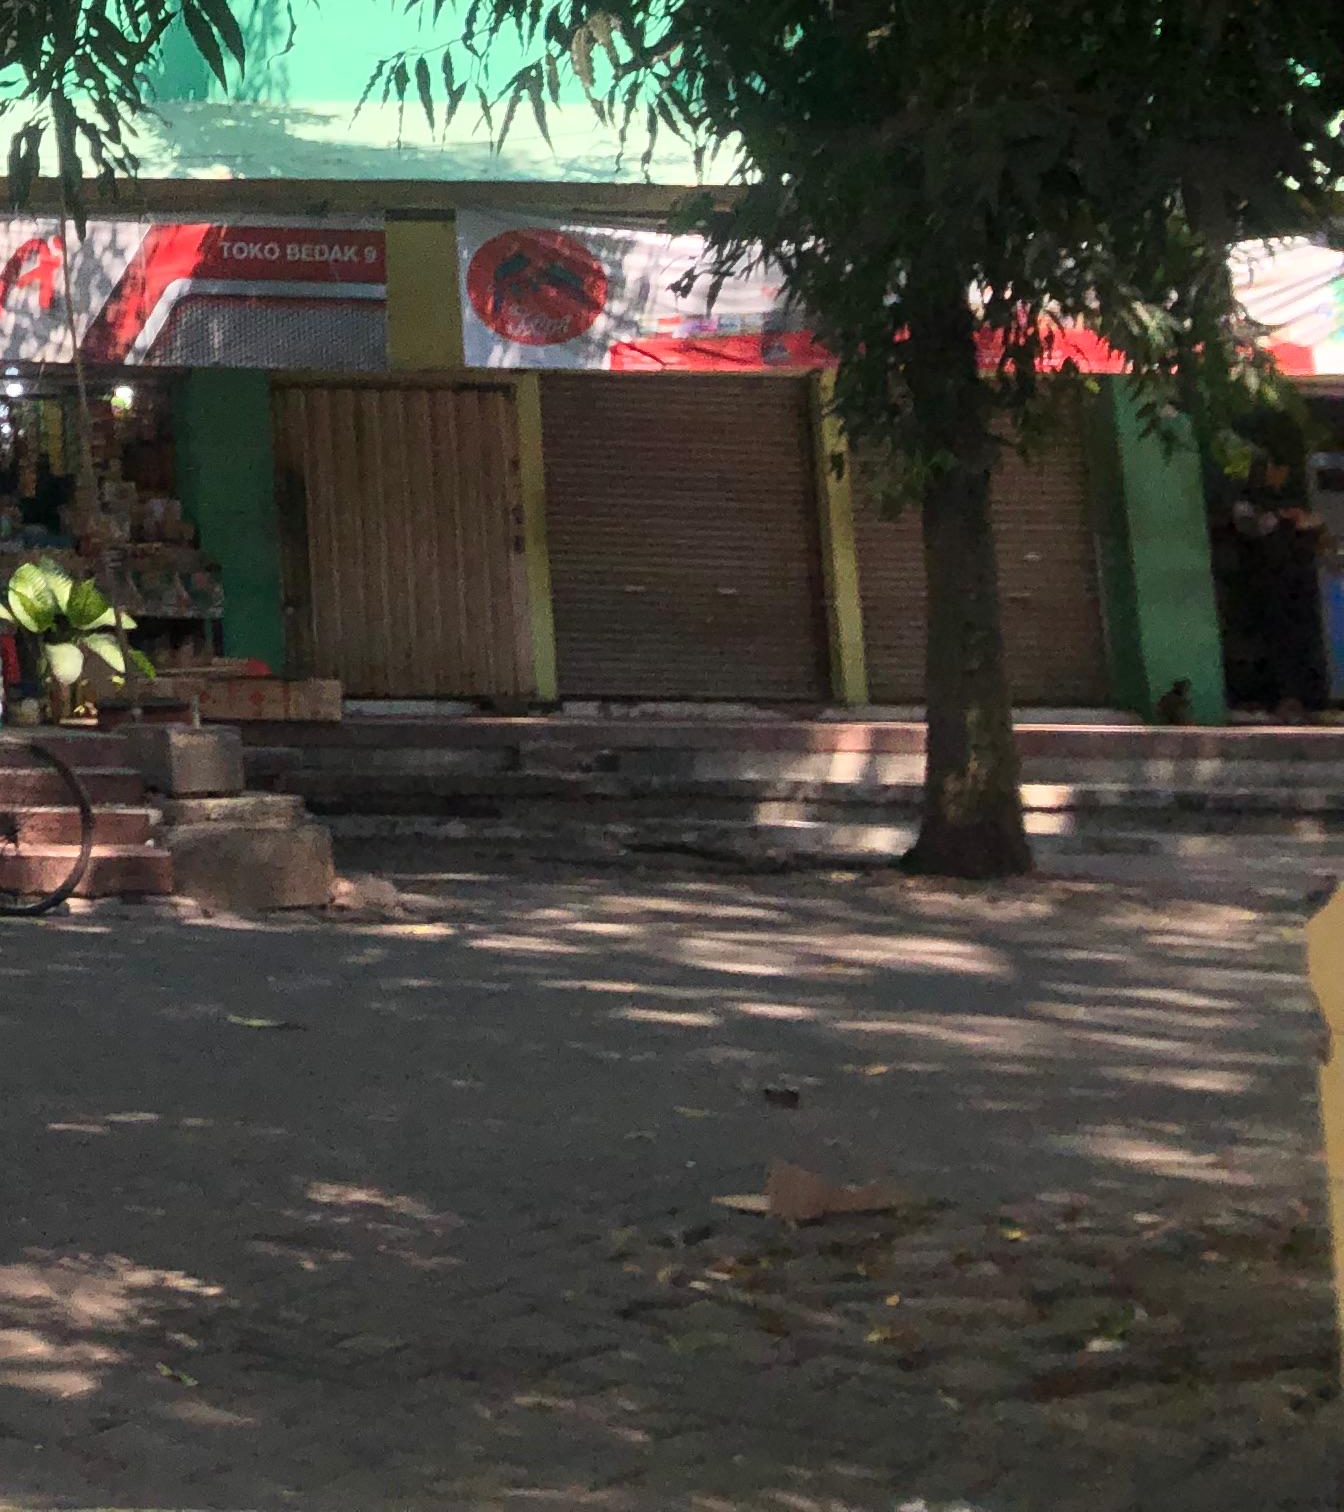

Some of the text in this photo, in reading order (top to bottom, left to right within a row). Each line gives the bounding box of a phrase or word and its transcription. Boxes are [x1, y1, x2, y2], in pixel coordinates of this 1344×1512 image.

[219, 241, 377, 264] TOKO BEDAK 9
